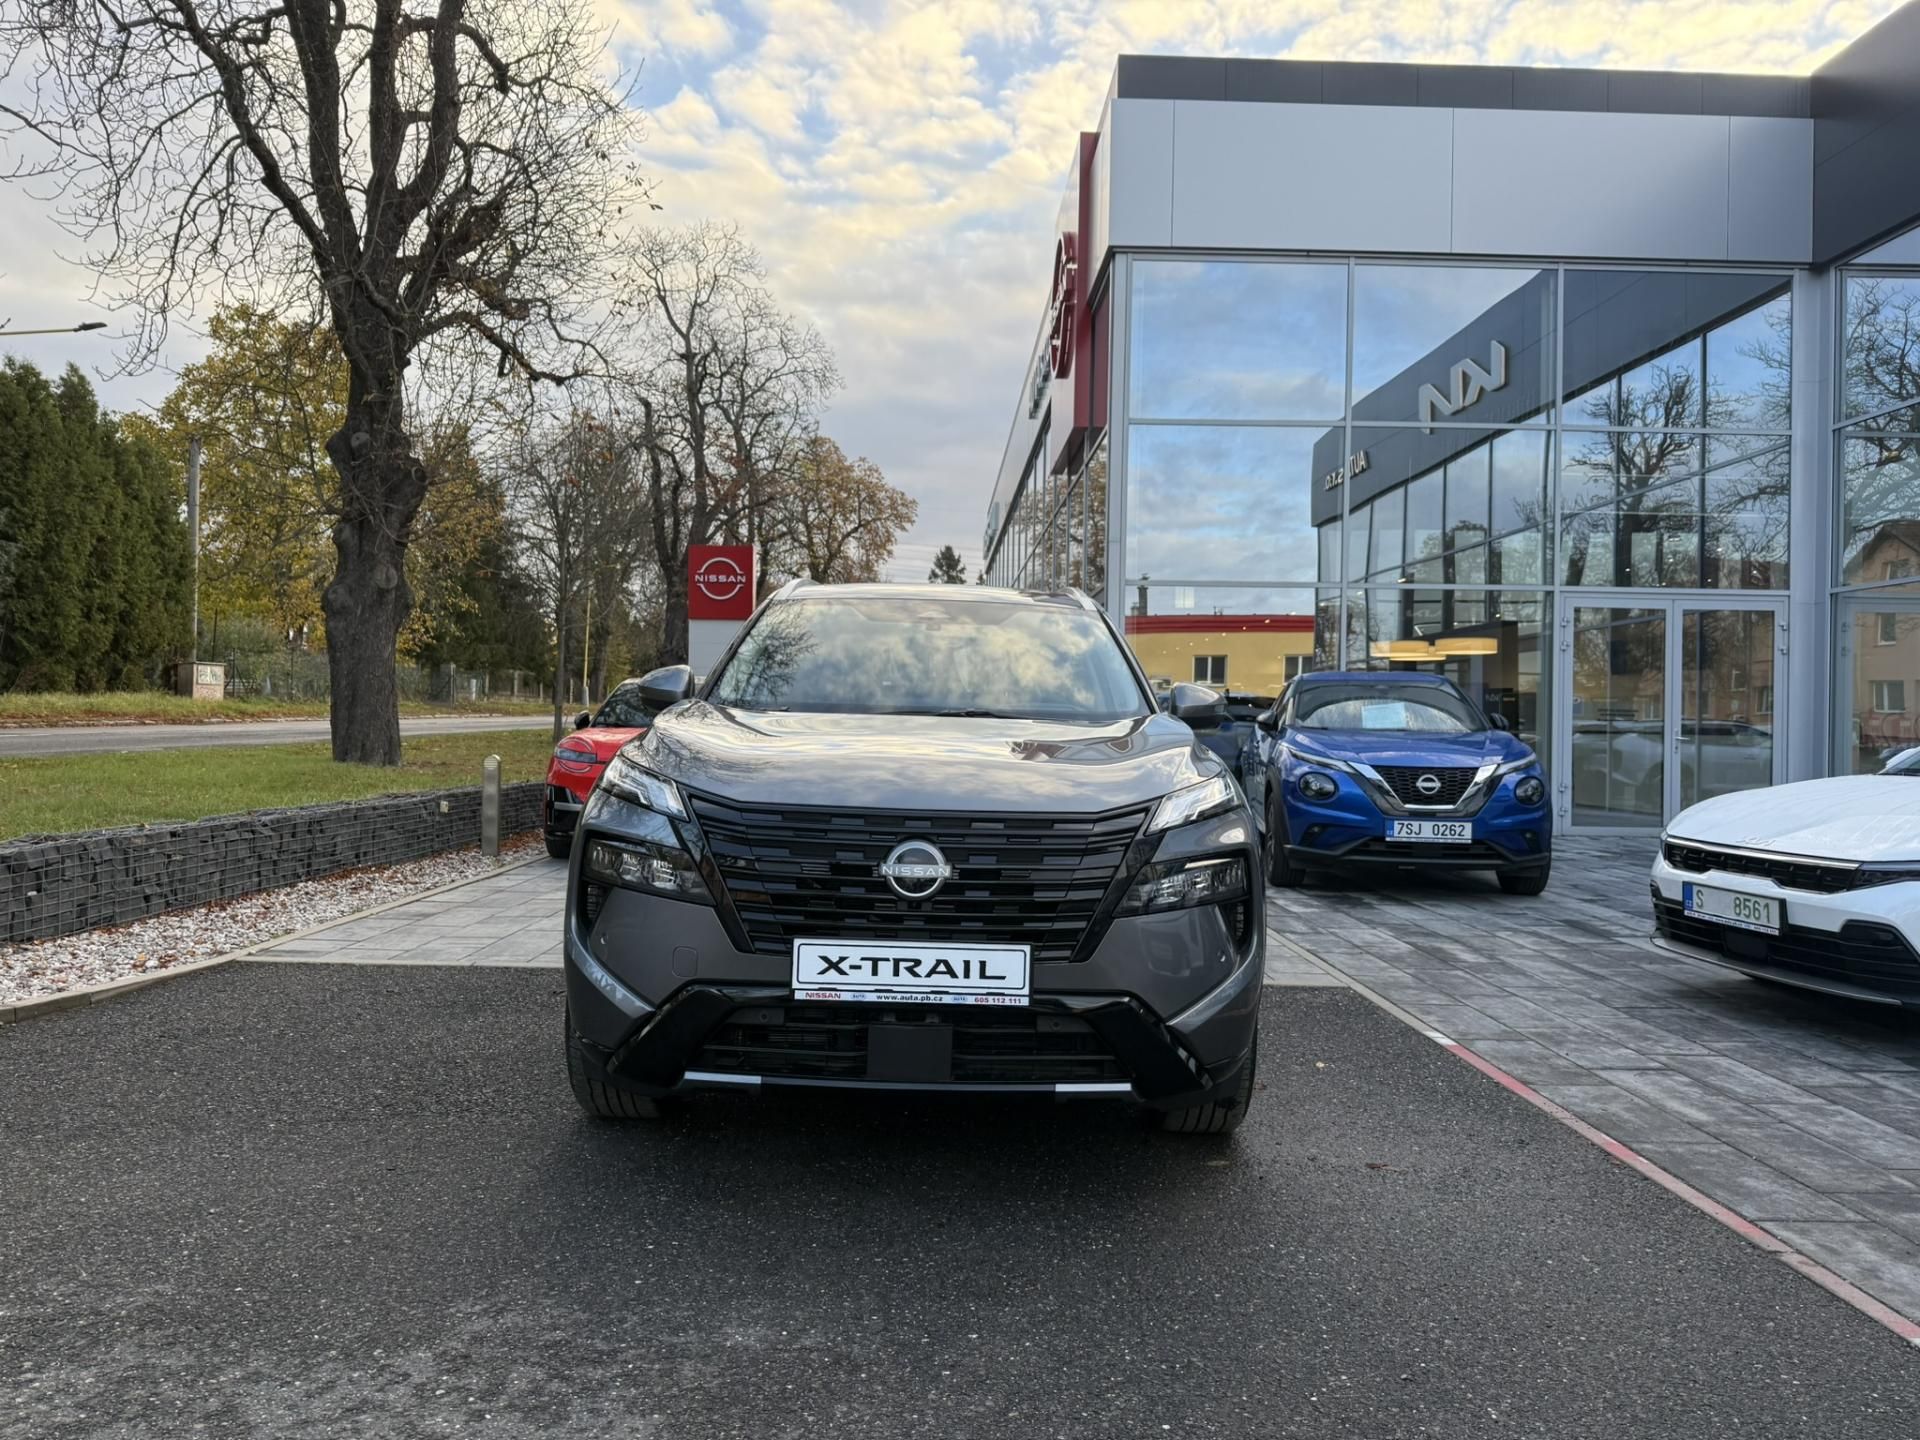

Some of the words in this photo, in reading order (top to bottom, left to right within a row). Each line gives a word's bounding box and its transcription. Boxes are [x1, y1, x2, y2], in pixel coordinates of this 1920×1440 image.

[695, 574, 746, 583] NISSAN
[1397, 822, 1422, 836] 7SJ
[1432, 823, 1466, 837] 0262
[882, 865, 949, 877] NISSAN
[1696, 889, 1704, 909] S
[1733, 896, 1770, 924] 8561
[816, 955, 1007, 980] X-TRAIL
[876, 994, 943, 1002] www.auta.pb.cz
